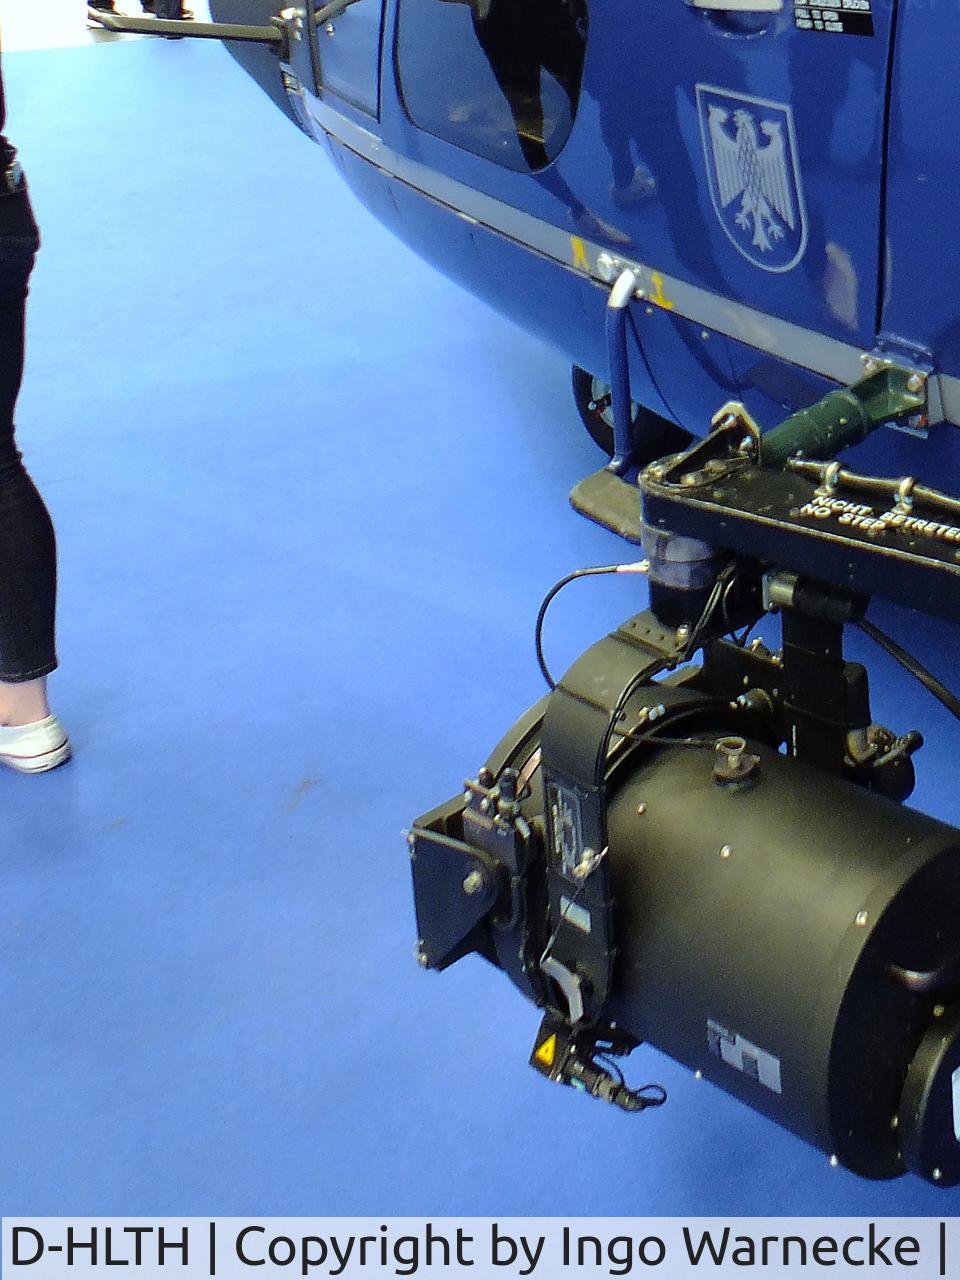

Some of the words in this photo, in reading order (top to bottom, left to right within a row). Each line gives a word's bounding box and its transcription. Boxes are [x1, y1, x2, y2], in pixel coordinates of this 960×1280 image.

[800, 503, 831, 519] NO
[838, 513, 887, 531] STEP
[812, 495, 873, 516] NICHT
